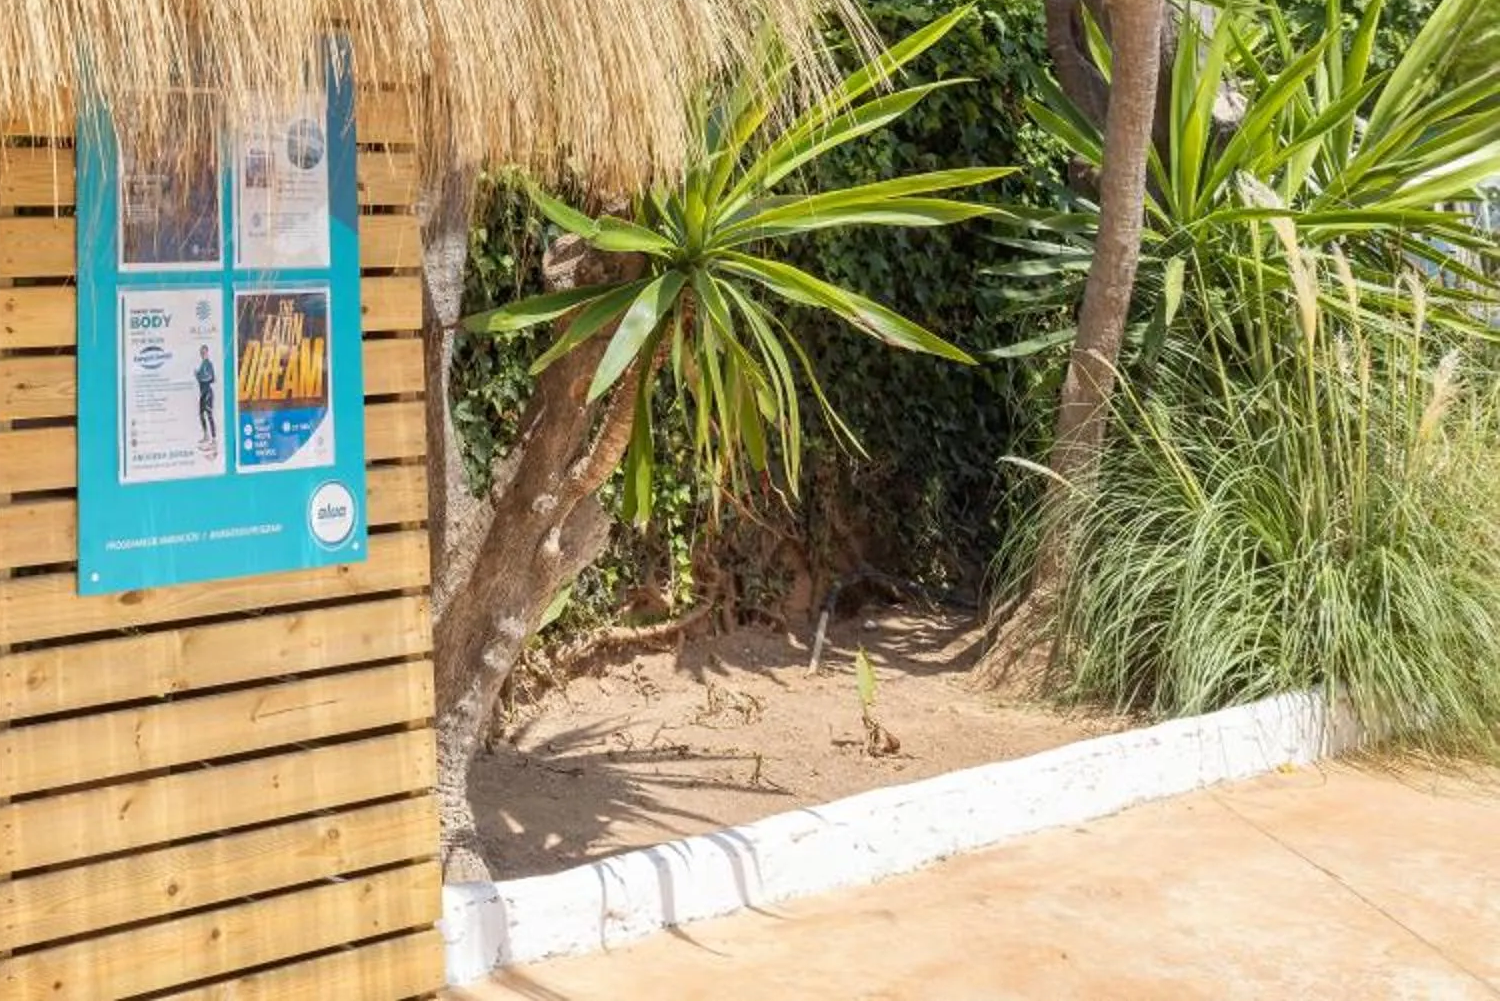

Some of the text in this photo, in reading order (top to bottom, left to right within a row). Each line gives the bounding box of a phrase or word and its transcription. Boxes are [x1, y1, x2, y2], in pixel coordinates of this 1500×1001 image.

[130, 314, 172, 329] BODY
[238, 337, 324, 401] DREAM
[317, 502, 347, 519] alua
